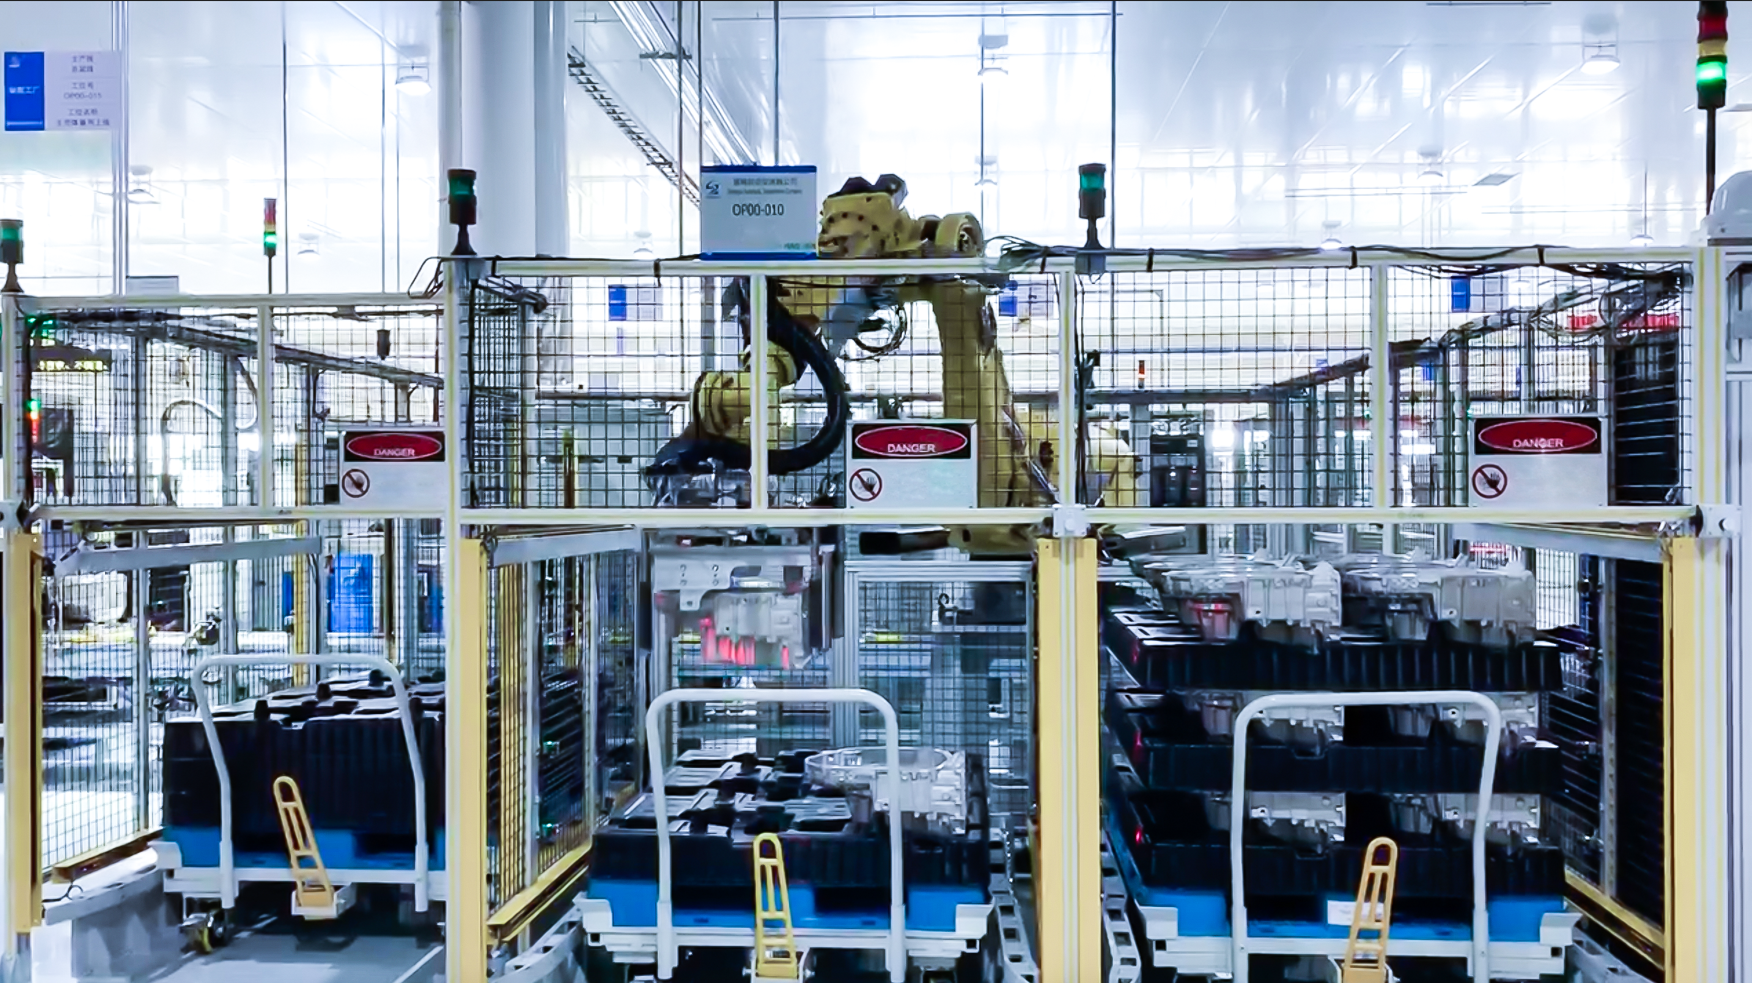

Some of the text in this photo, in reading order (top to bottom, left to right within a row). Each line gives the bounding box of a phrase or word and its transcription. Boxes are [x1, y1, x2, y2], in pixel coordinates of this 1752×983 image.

[732, 203, 785, 216] OP00-010
[887, 443, 936, 453] DANGER
[1512, 438, 1564, 448] DANGER
[373, 447, 415, 457] DANGER
